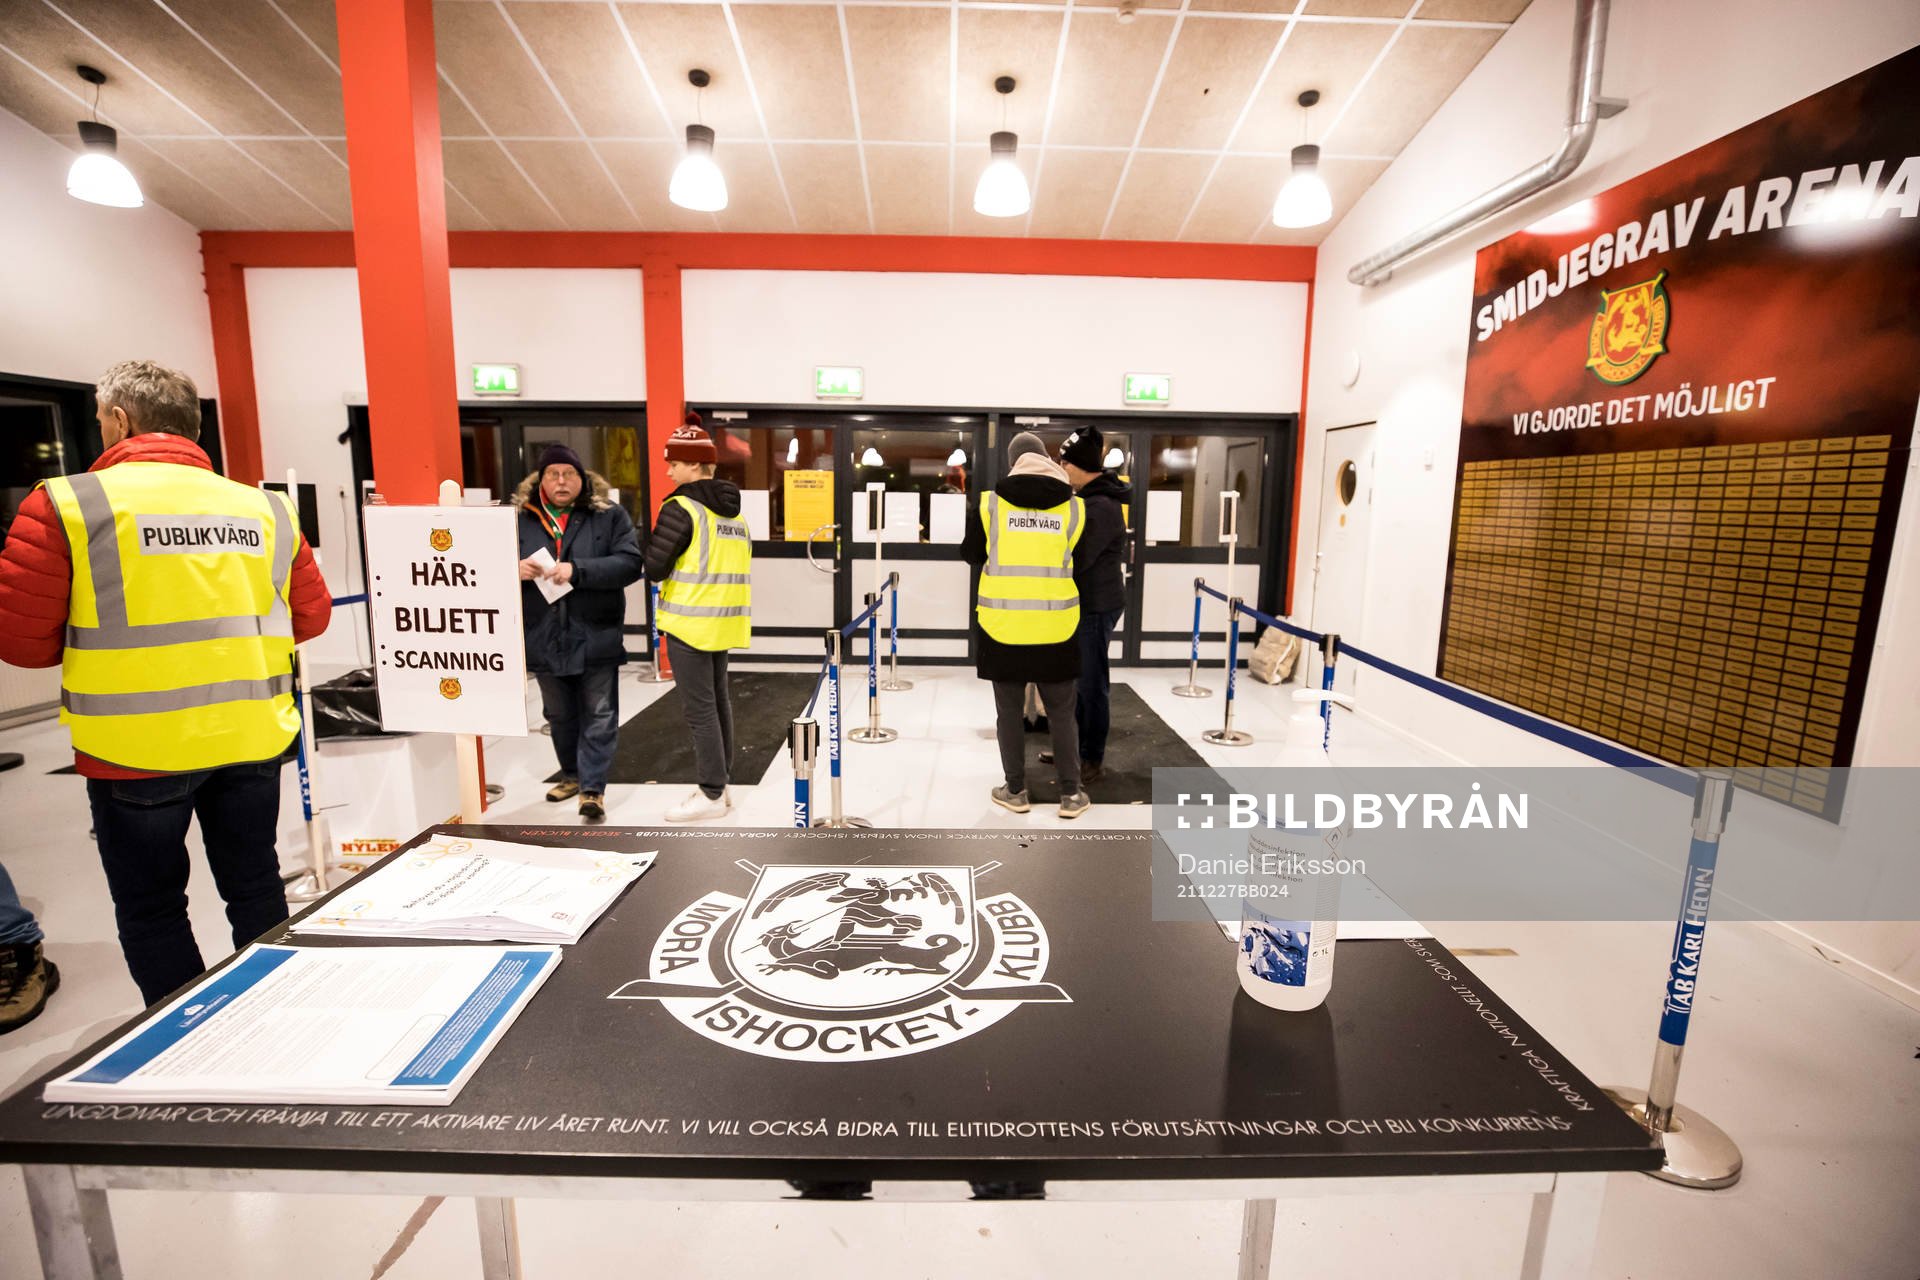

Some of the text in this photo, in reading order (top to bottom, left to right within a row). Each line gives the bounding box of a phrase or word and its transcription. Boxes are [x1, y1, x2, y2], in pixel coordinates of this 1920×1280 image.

[1476, 196, 1706, 342] SMIDJEGRAV
[1708, 156, 1920, 240] ARENA
[1513, 377, 1776, 435] VI GJORDE DET MÖJLIGT
[411, 556, 477, 587] HÄR:
[394, 606, 500, 635] BILJETT
[394, 650, 505, 672] SCANNING
[794, 801, 807, 827] DIN
[739, 831, 778, 839] MORA
[853, 832, 900, 840] SVENSK
[904, 832, 942, 840] INOM
[1685, 868, 1714, 928] HEDIN
[658, 901, 723, 975] MORA
[992, 899, 1041, 981] KLUBB
[1676, 930, 1704, 977] KARL
[1426, 959, 1458, 981] SOM
[691, 999, 981, 1054] ISHOCKEY-
[1521, 1050, 1595, 1111] KRAFTIGA
[42, 1104, 1573, 1138] UNGDOMAR OCH FRÄMJA TILL ETT AKTIVARE LIV ÅRET RUNT. VI VILL OCKSÅ BIDRA TILL ELITIDROTTENS FÖRUTSÄTTNINGAR OCH BLI KONKURRENS-
